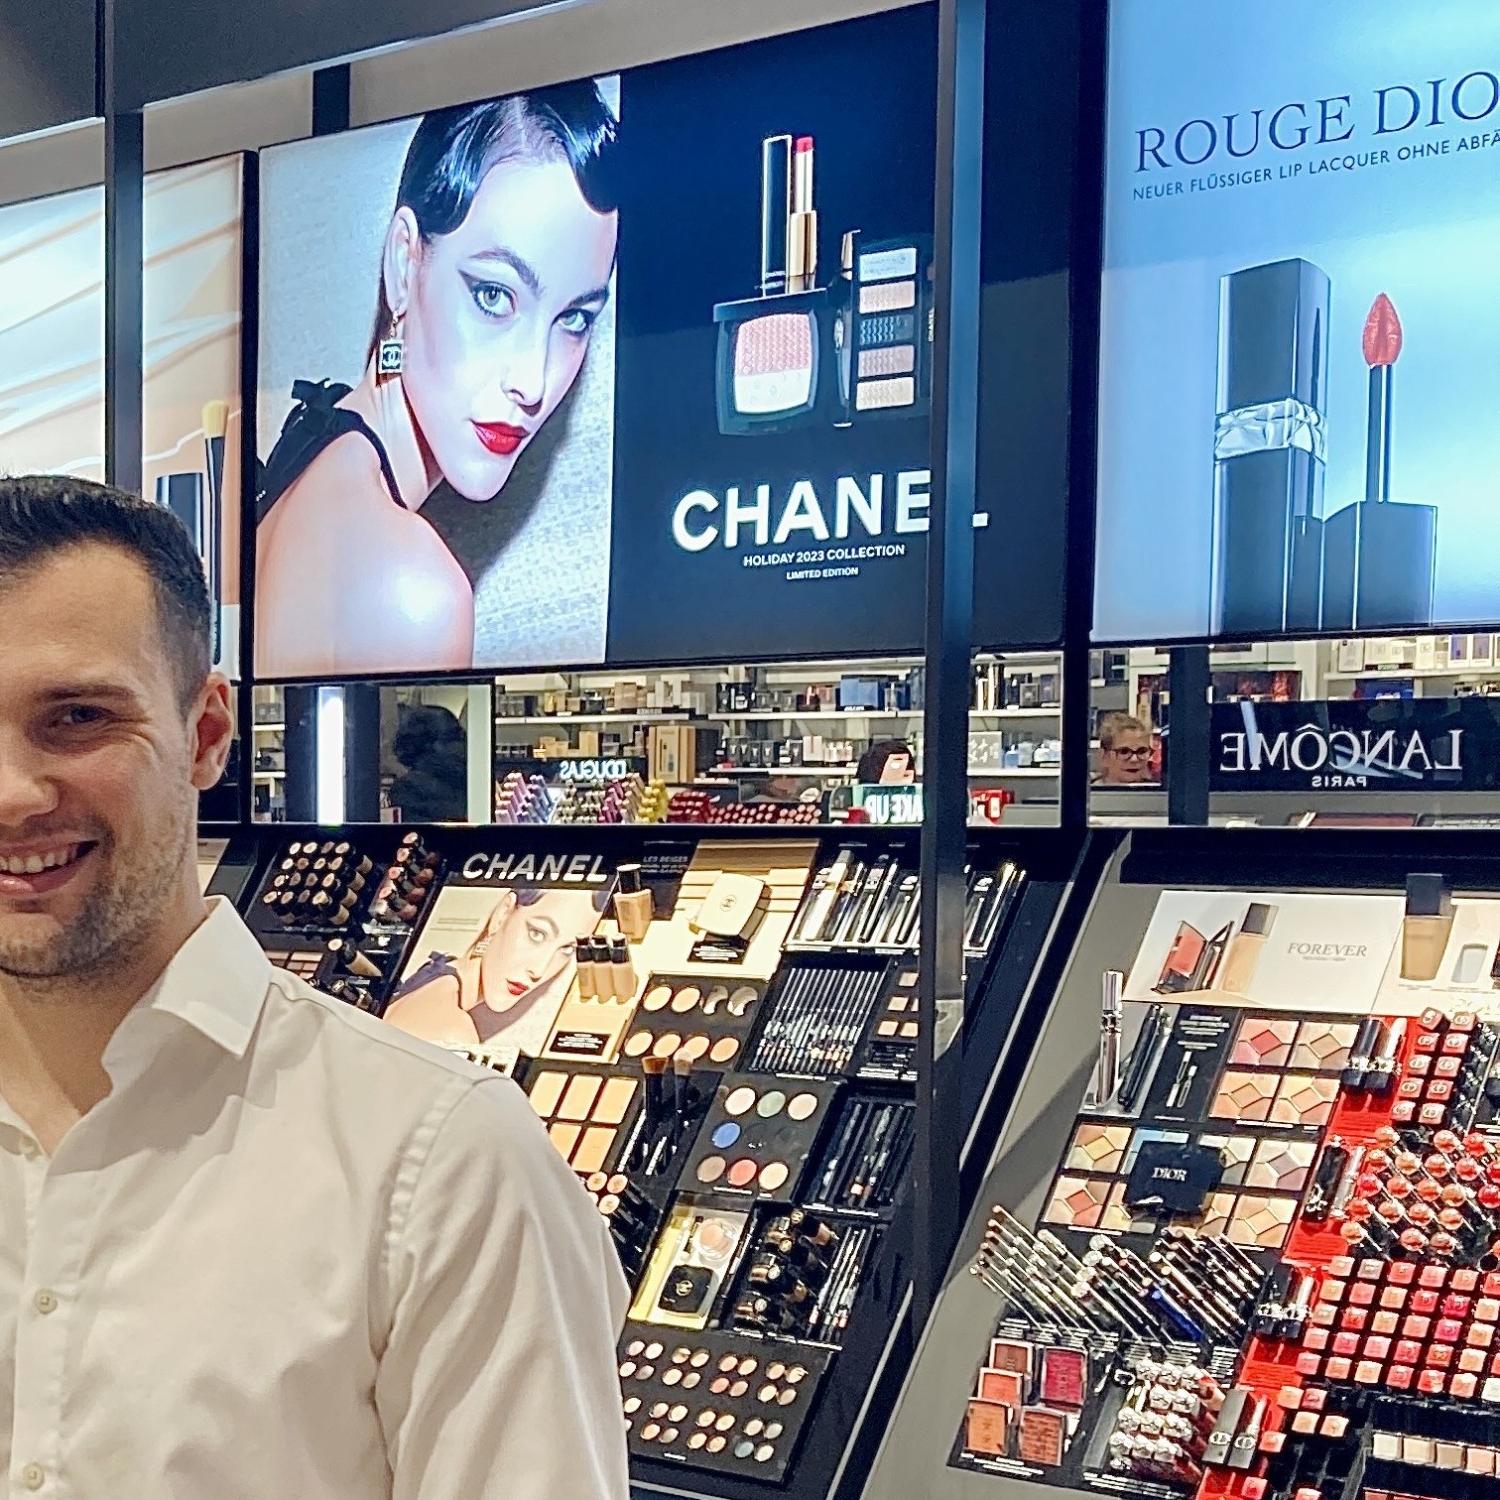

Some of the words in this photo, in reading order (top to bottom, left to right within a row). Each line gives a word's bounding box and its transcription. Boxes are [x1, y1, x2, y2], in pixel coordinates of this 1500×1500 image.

[1134, 95, 1355, 173] ROUGE
[1372, 71, 1500, 136] DIO
[1133, 181, 1184, 200] NEUER
[1190, 168, 1272, 192] FLÜSSIGER
[1279, 163, 1302, 179] LIP
[1309, 150, 1390, 174] LACQUER
[1397, 139, 1450, 161] OHNE
[672, 469, 988, 551] CHANE
[743, 551, 795, 567] HOLIDAY
[796, 549, 825, 563] 2023
[826, 544, 905, 560] COLLECTION
[786, 568, 821, 580] LIMITED
[822, 566, 858, 578] EDITION
[463, 852, 607, 882] CHANEL
[1287, 942, 1367, 957] FOREVER
[1151, 1167, 1187, 1181] DIOR
